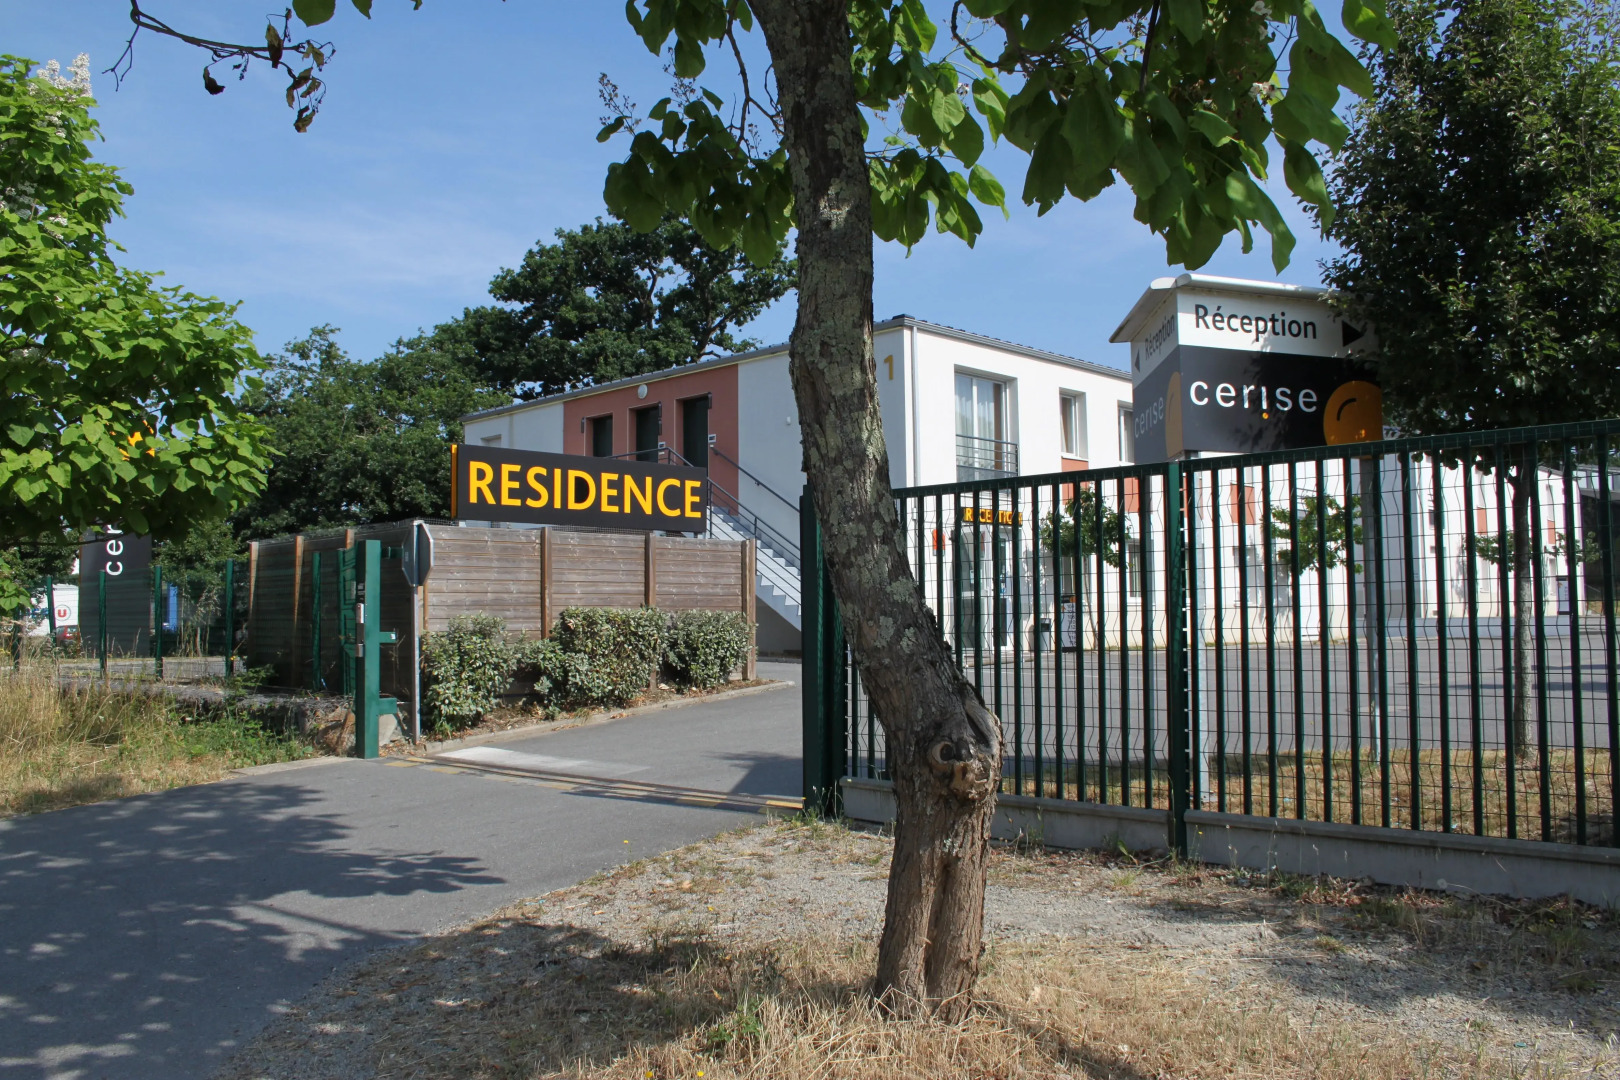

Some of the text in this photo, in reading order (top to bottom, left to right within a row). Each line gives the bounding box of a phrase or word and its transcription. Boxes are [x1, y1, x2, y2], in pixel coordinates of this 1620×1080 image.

[1145, 314, 1175, 361] Réception
[1194, 303, 1317, 342] Réception
[883, 354, 894, 380] 1
[1134, 397, 1164, 438] cerise
[1189, 380, 1318, 419] cerise
[469, 460, 702, 518] RESIDENCE
[964, 507, 1023, 525] RCETIO
[106, 523, 124, 576] cer
